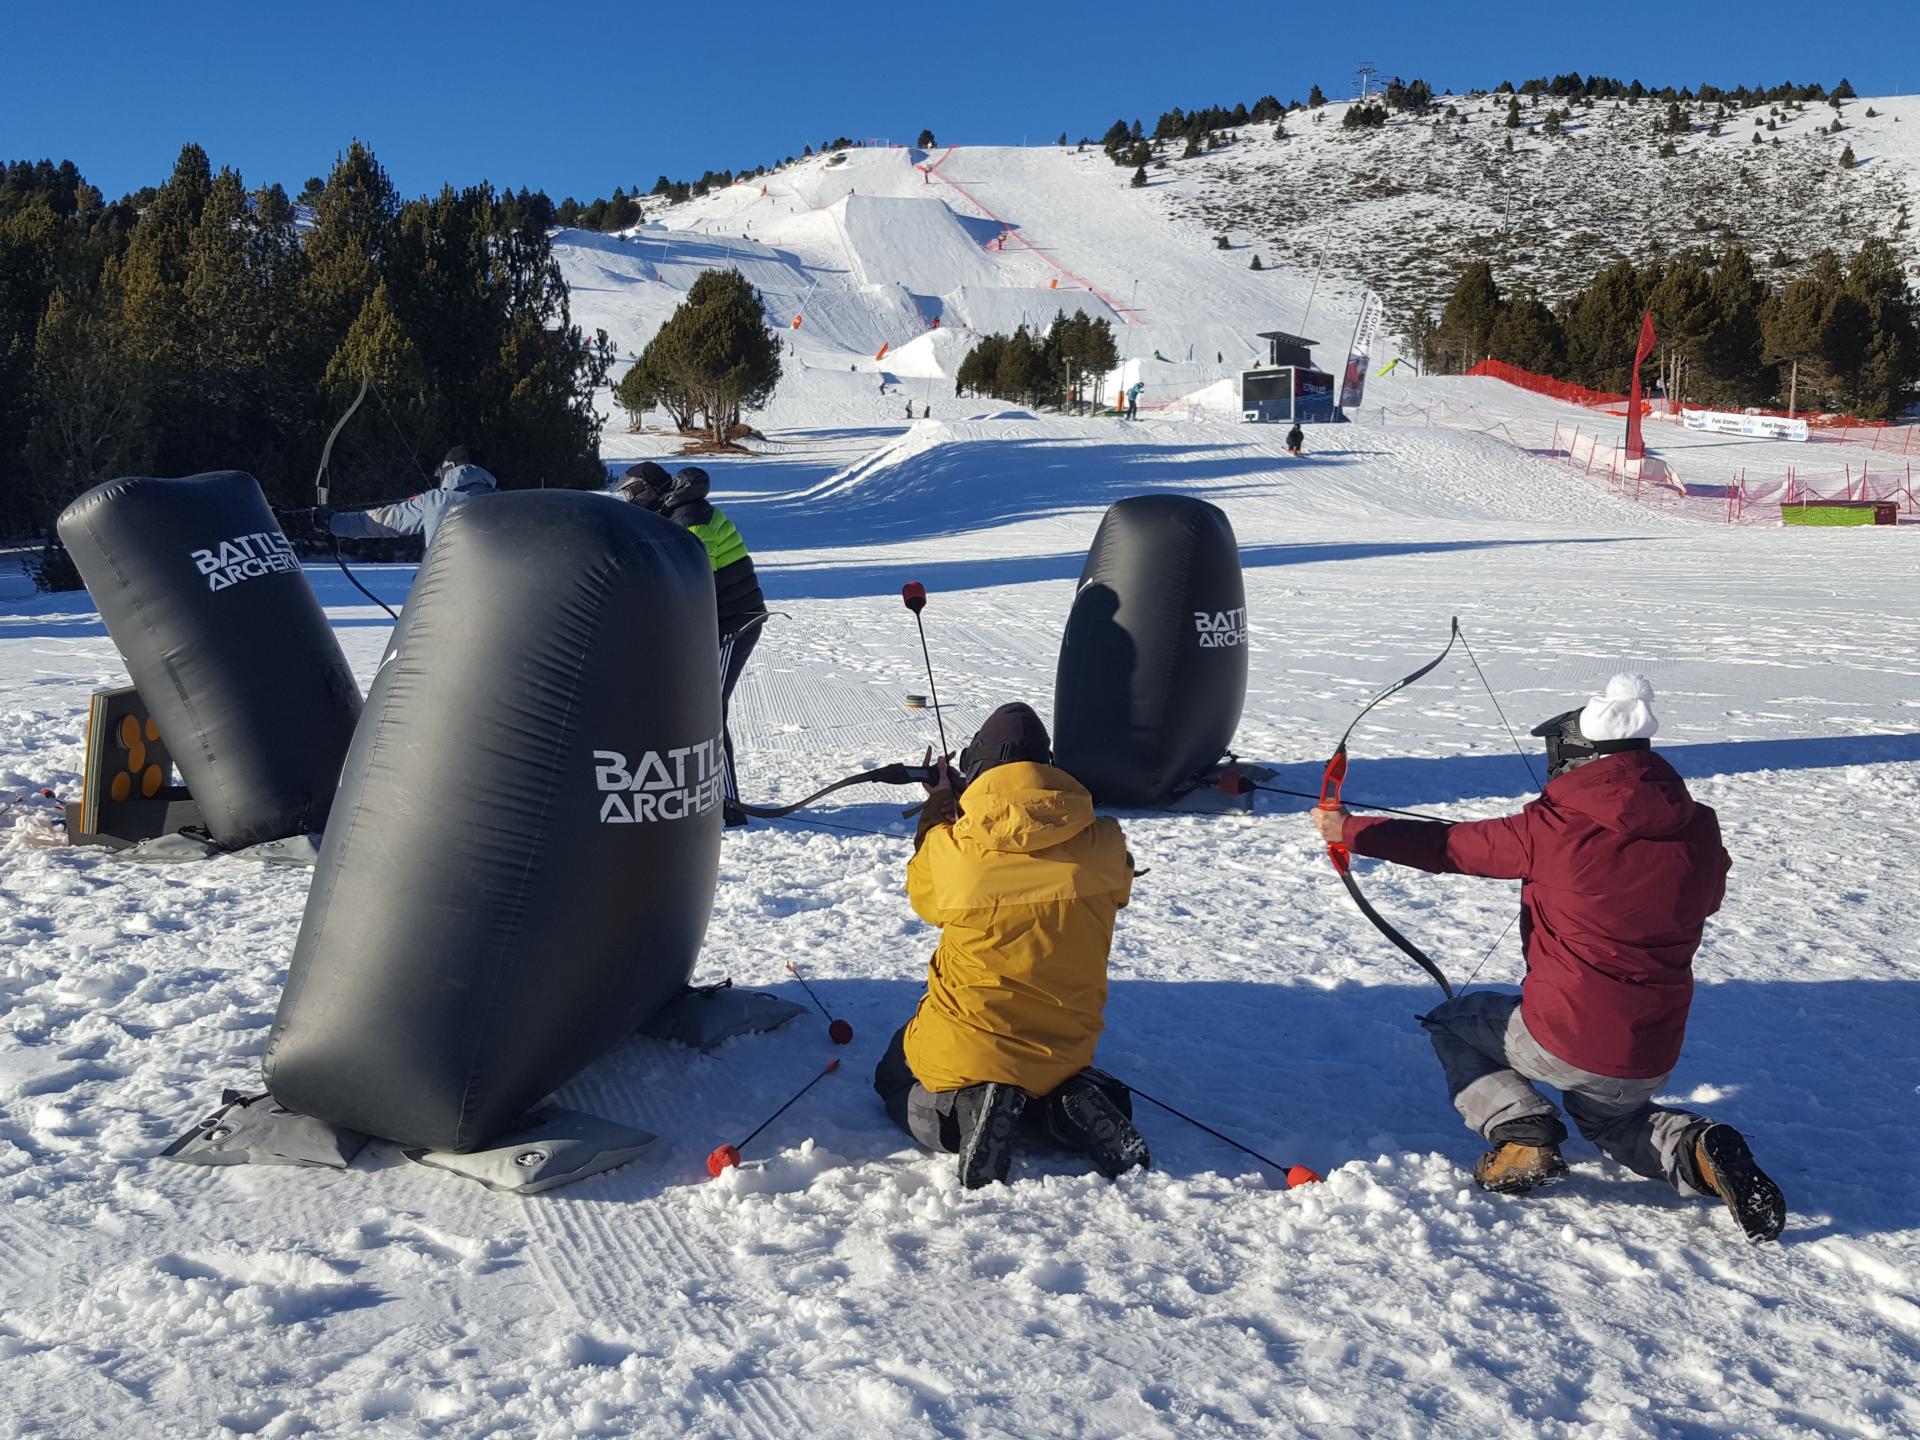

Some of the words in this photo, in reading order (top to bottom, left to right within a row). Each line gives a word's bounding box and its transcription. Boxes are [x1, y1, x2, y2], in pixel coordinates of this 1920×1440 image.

[1357, 306, 1373, 345] FREESTYLE
[1365, 309, 1381, 348] MOTION
[209, 552, 300, 592] ARCHERY
